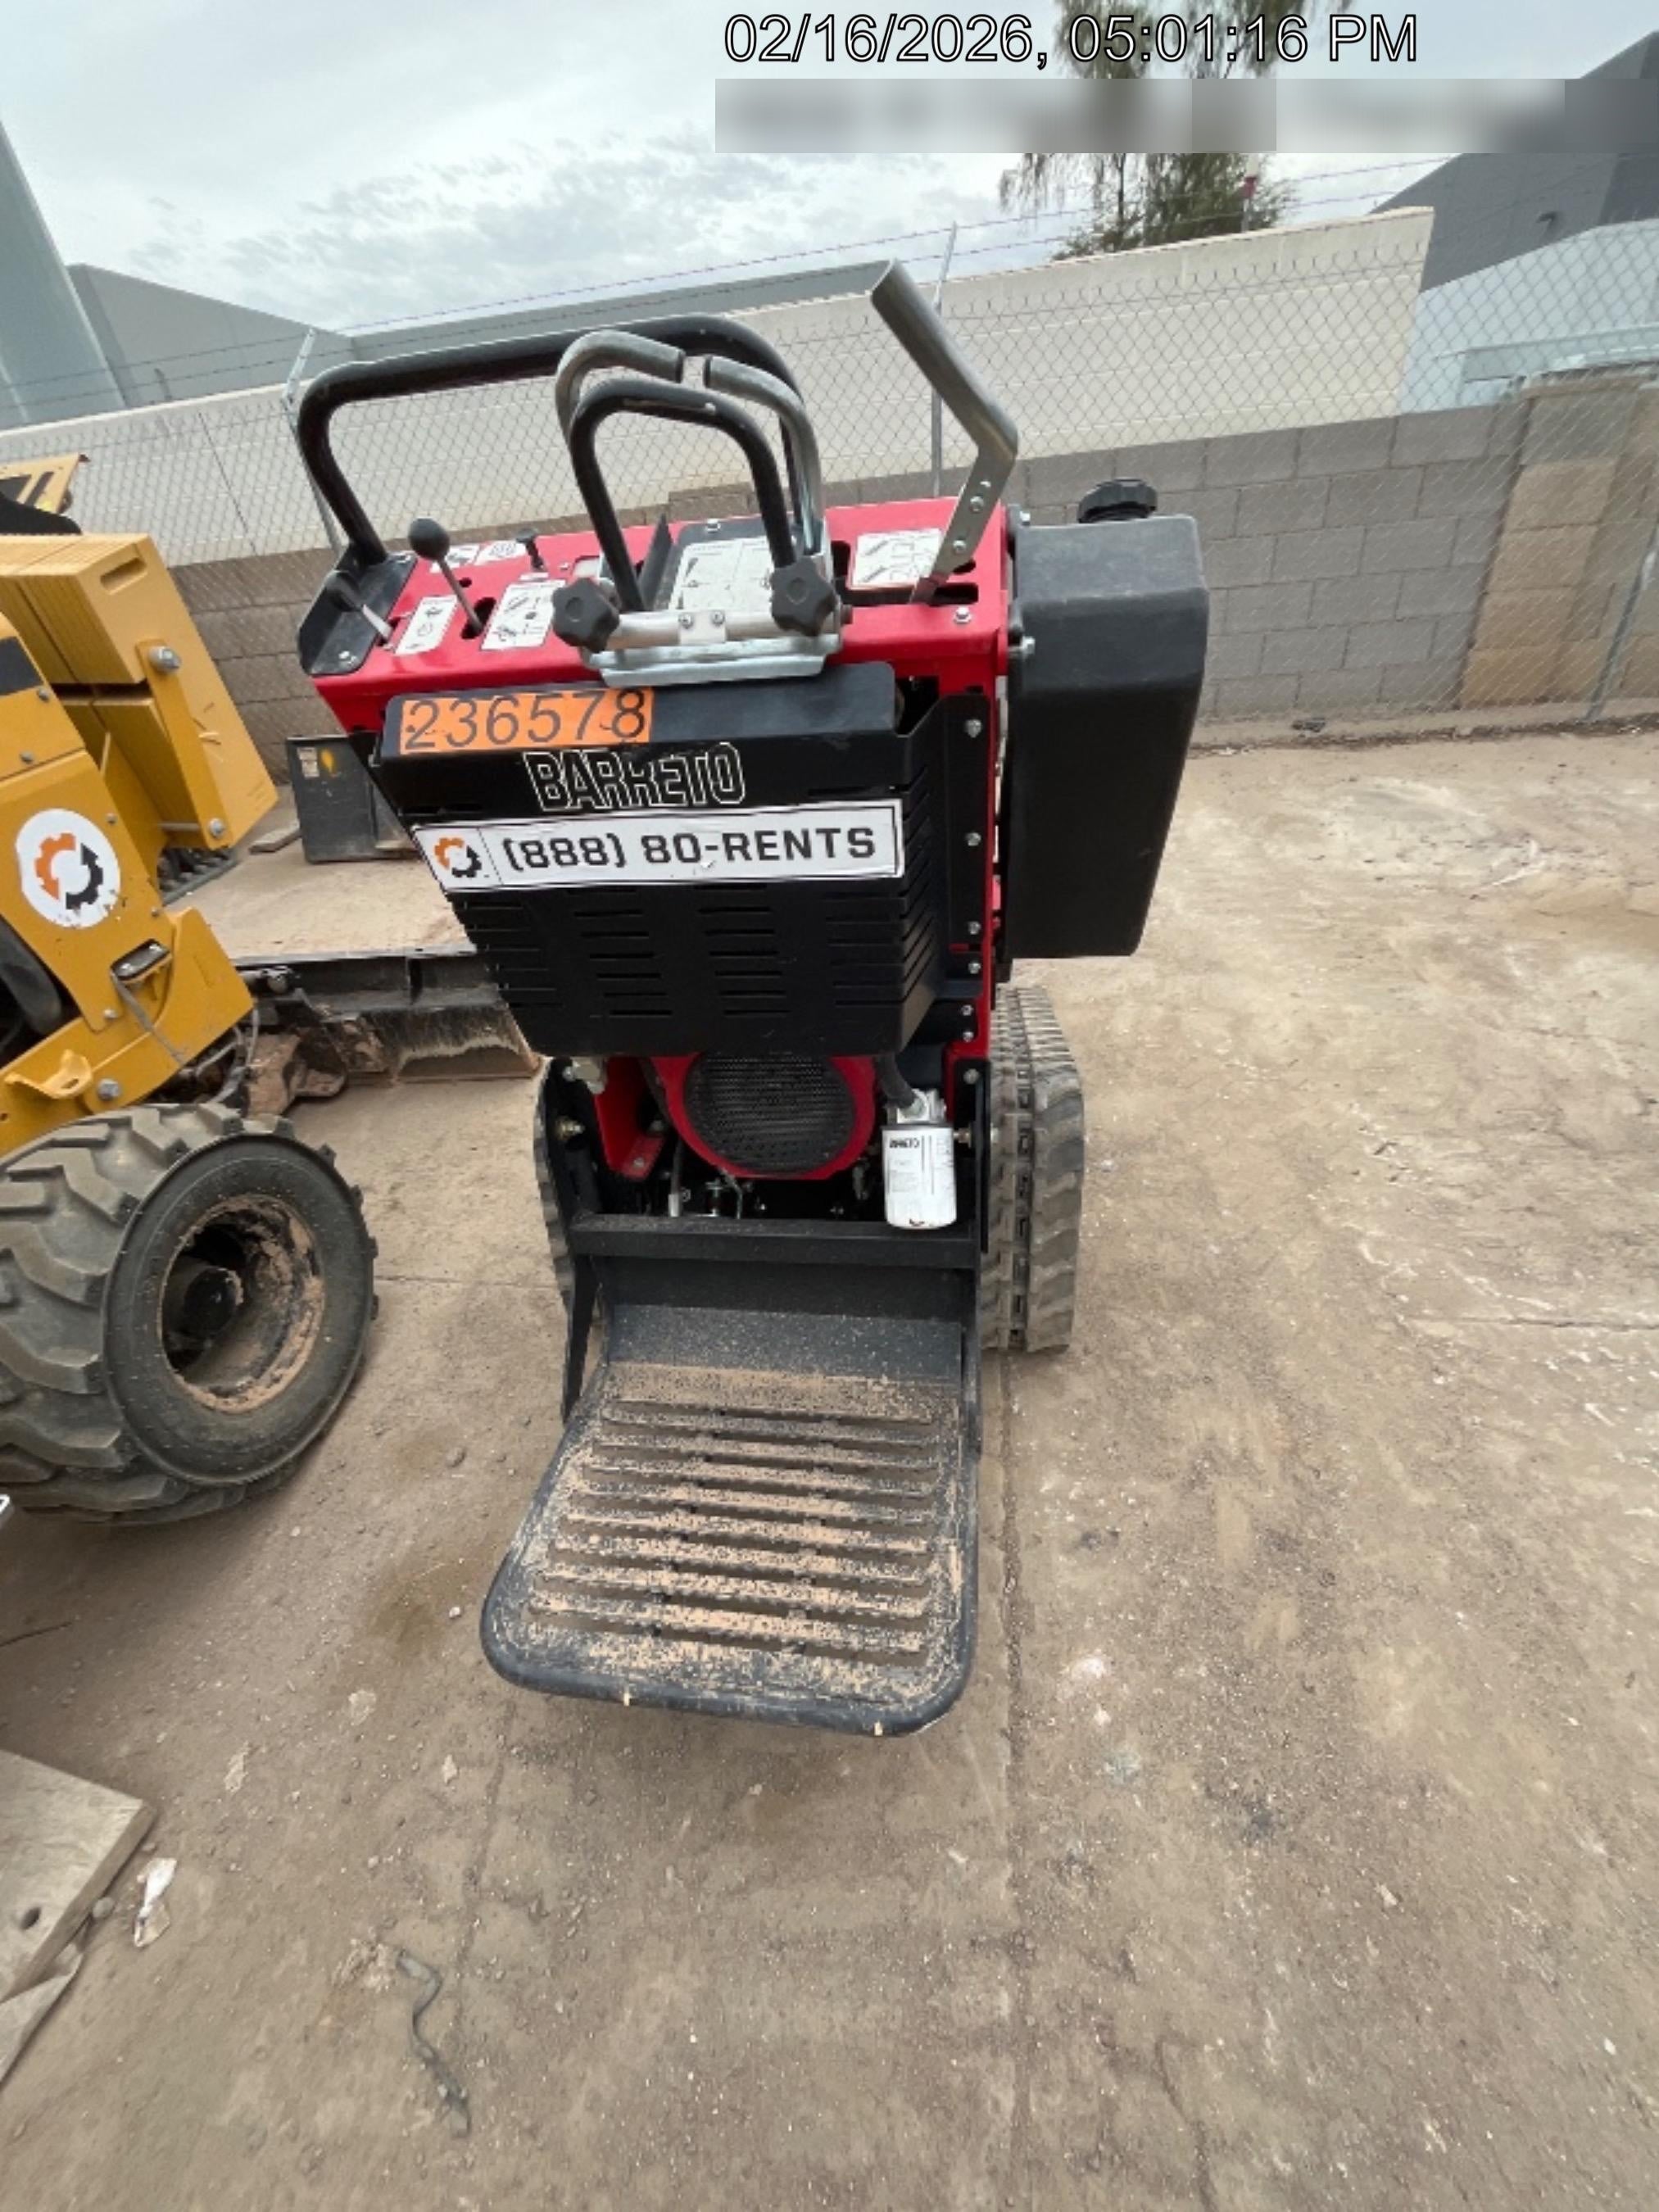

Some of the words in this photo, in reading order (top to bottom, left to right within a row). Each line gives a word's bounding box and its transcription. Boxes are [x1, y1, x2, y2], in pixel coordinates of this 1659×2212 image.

[405, 689, 646, 750] 236578
[503, 833, 625, 871] (888)
[642, 827, 876, 864] 80-RENTS
